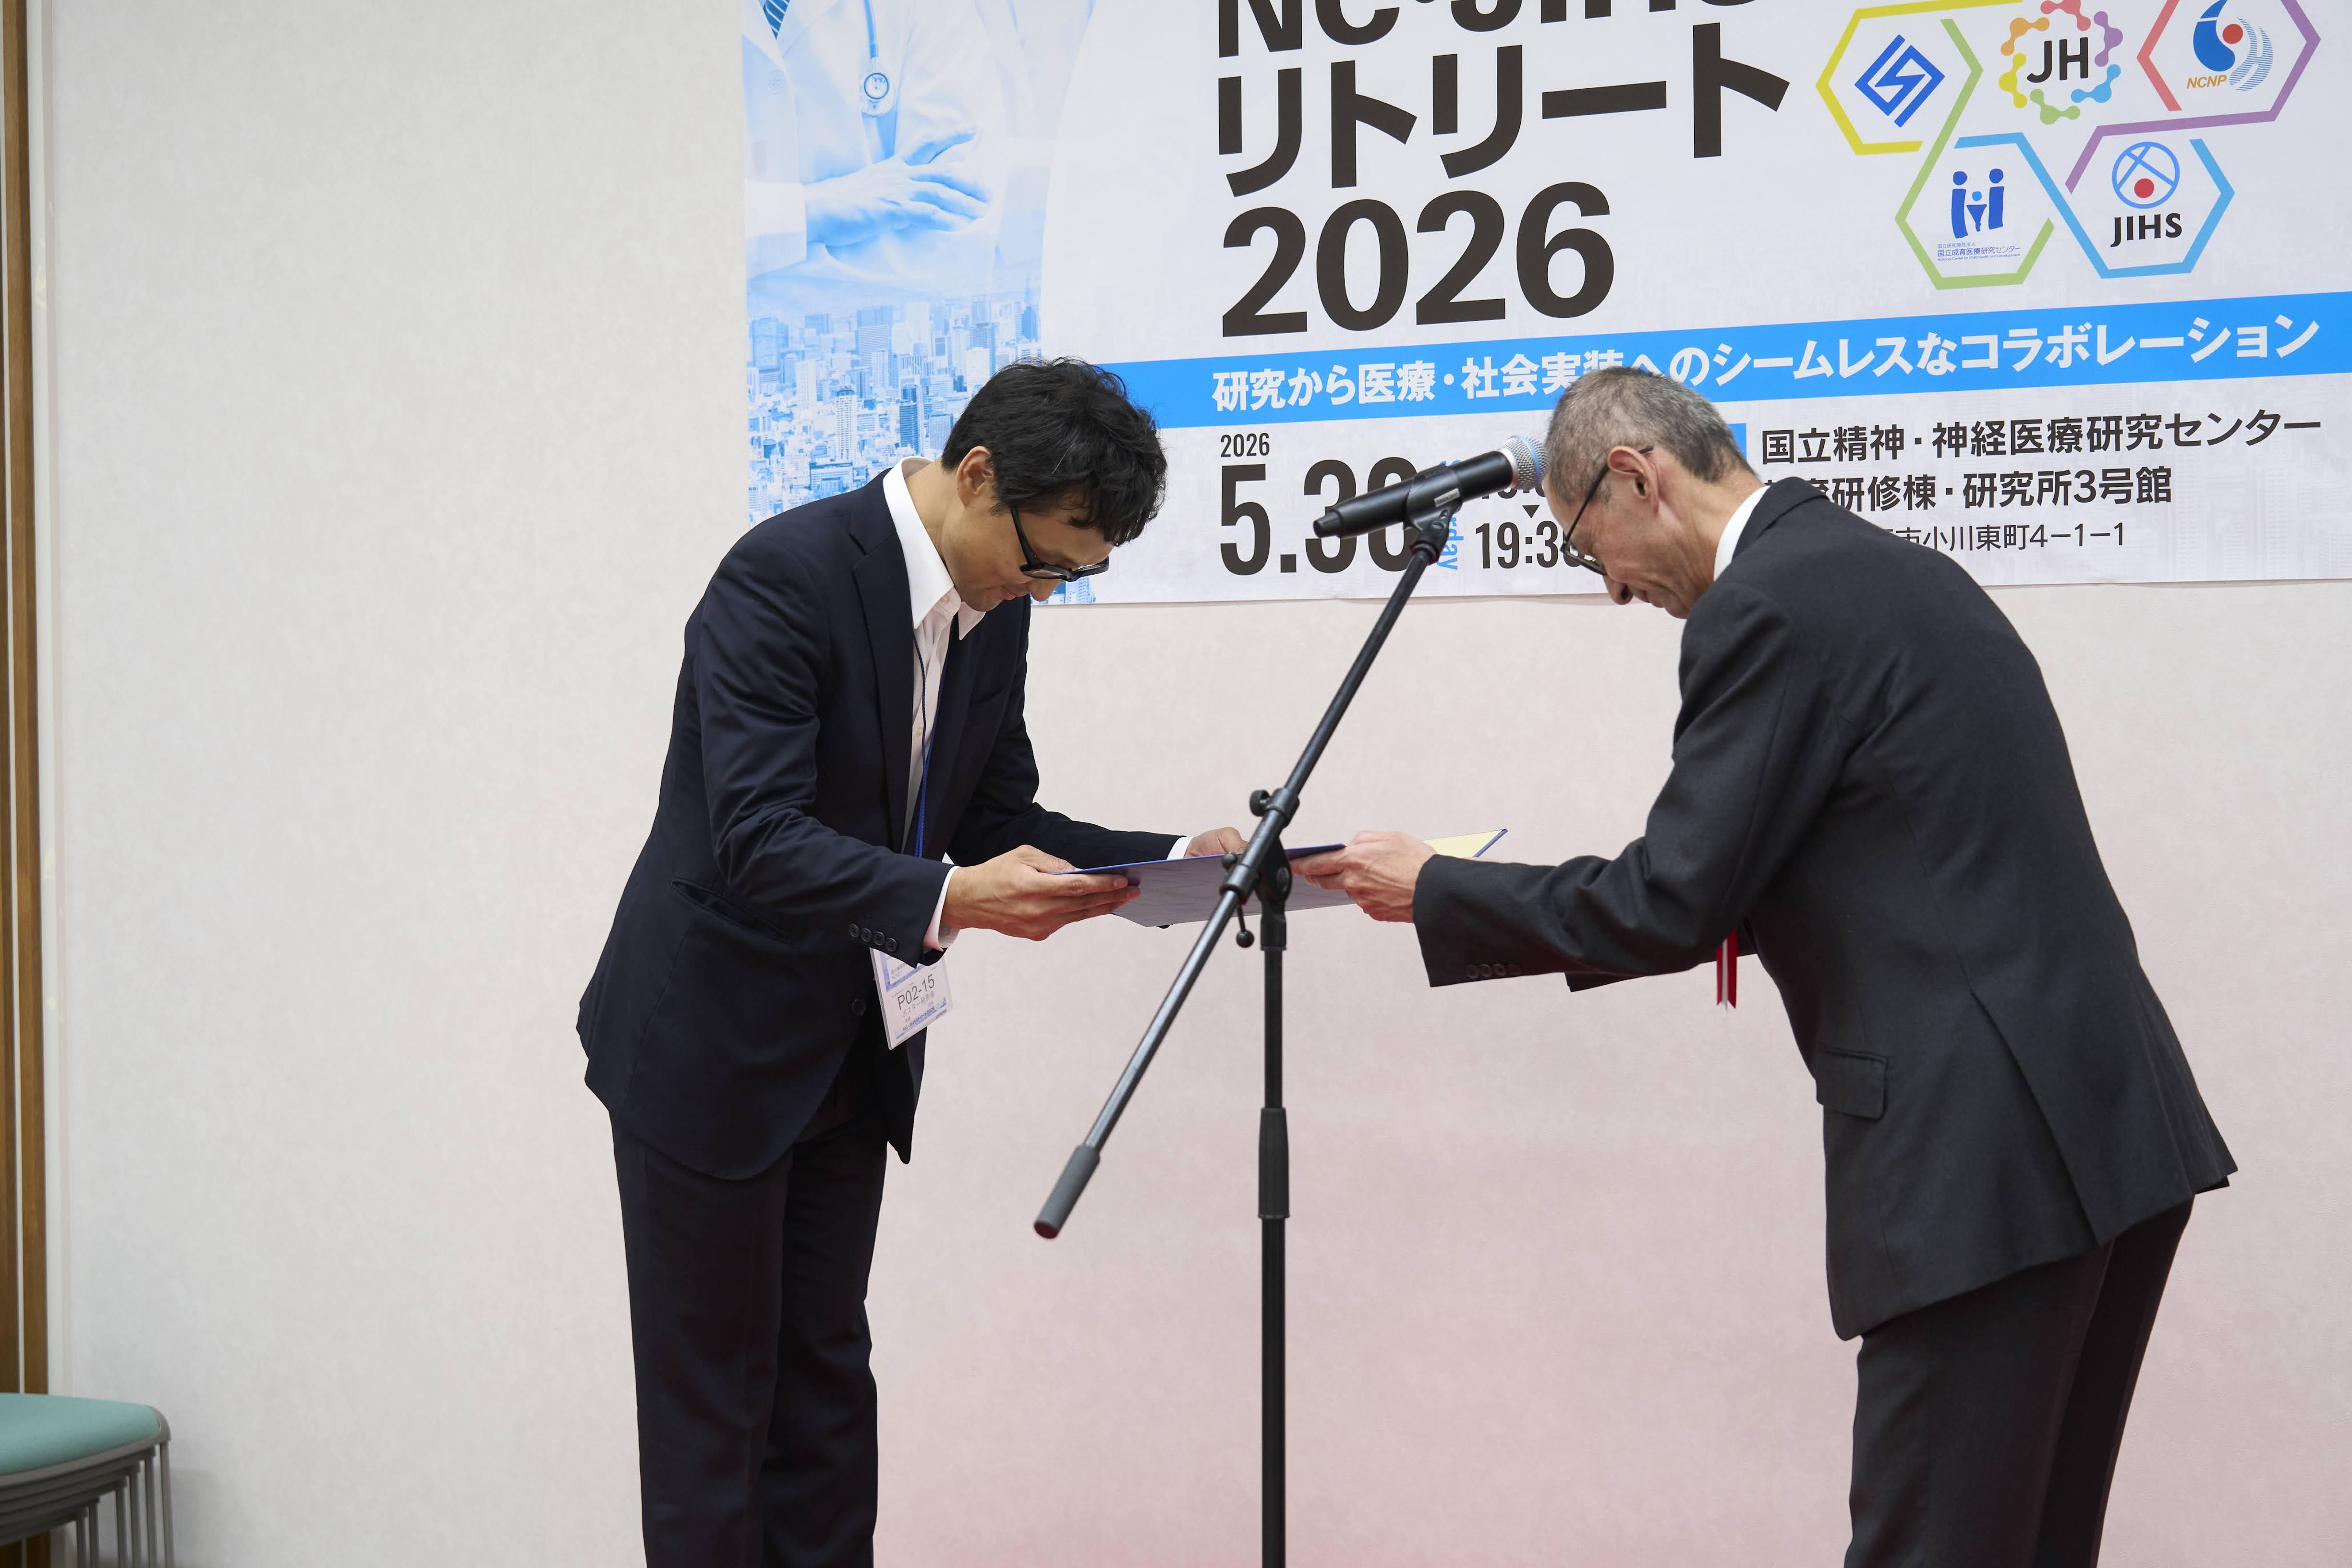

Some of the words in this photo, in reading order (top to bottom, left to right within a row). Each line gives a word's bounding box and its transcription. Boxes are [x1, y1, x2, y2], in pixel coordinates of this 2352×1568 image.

[2027, 36, 2089, 83] JH
[2187, 75, 2227, 89] NCNP
[1218, 23, 1790, 197] リトリート
[2110, 213, 2182, 247] JIHS
[1222, 181, 1614, 337] 2026
[1938, 246, 2020, 257] 国立成育医療研究センター
[1221, 433, 1270, 458] 2026
[1762, 409, 2321, 465] 国立精神・神経医療研究センター
[1475, 520, 1583, 569] 19:3
[897, 974, 935, 1010] P02-15
